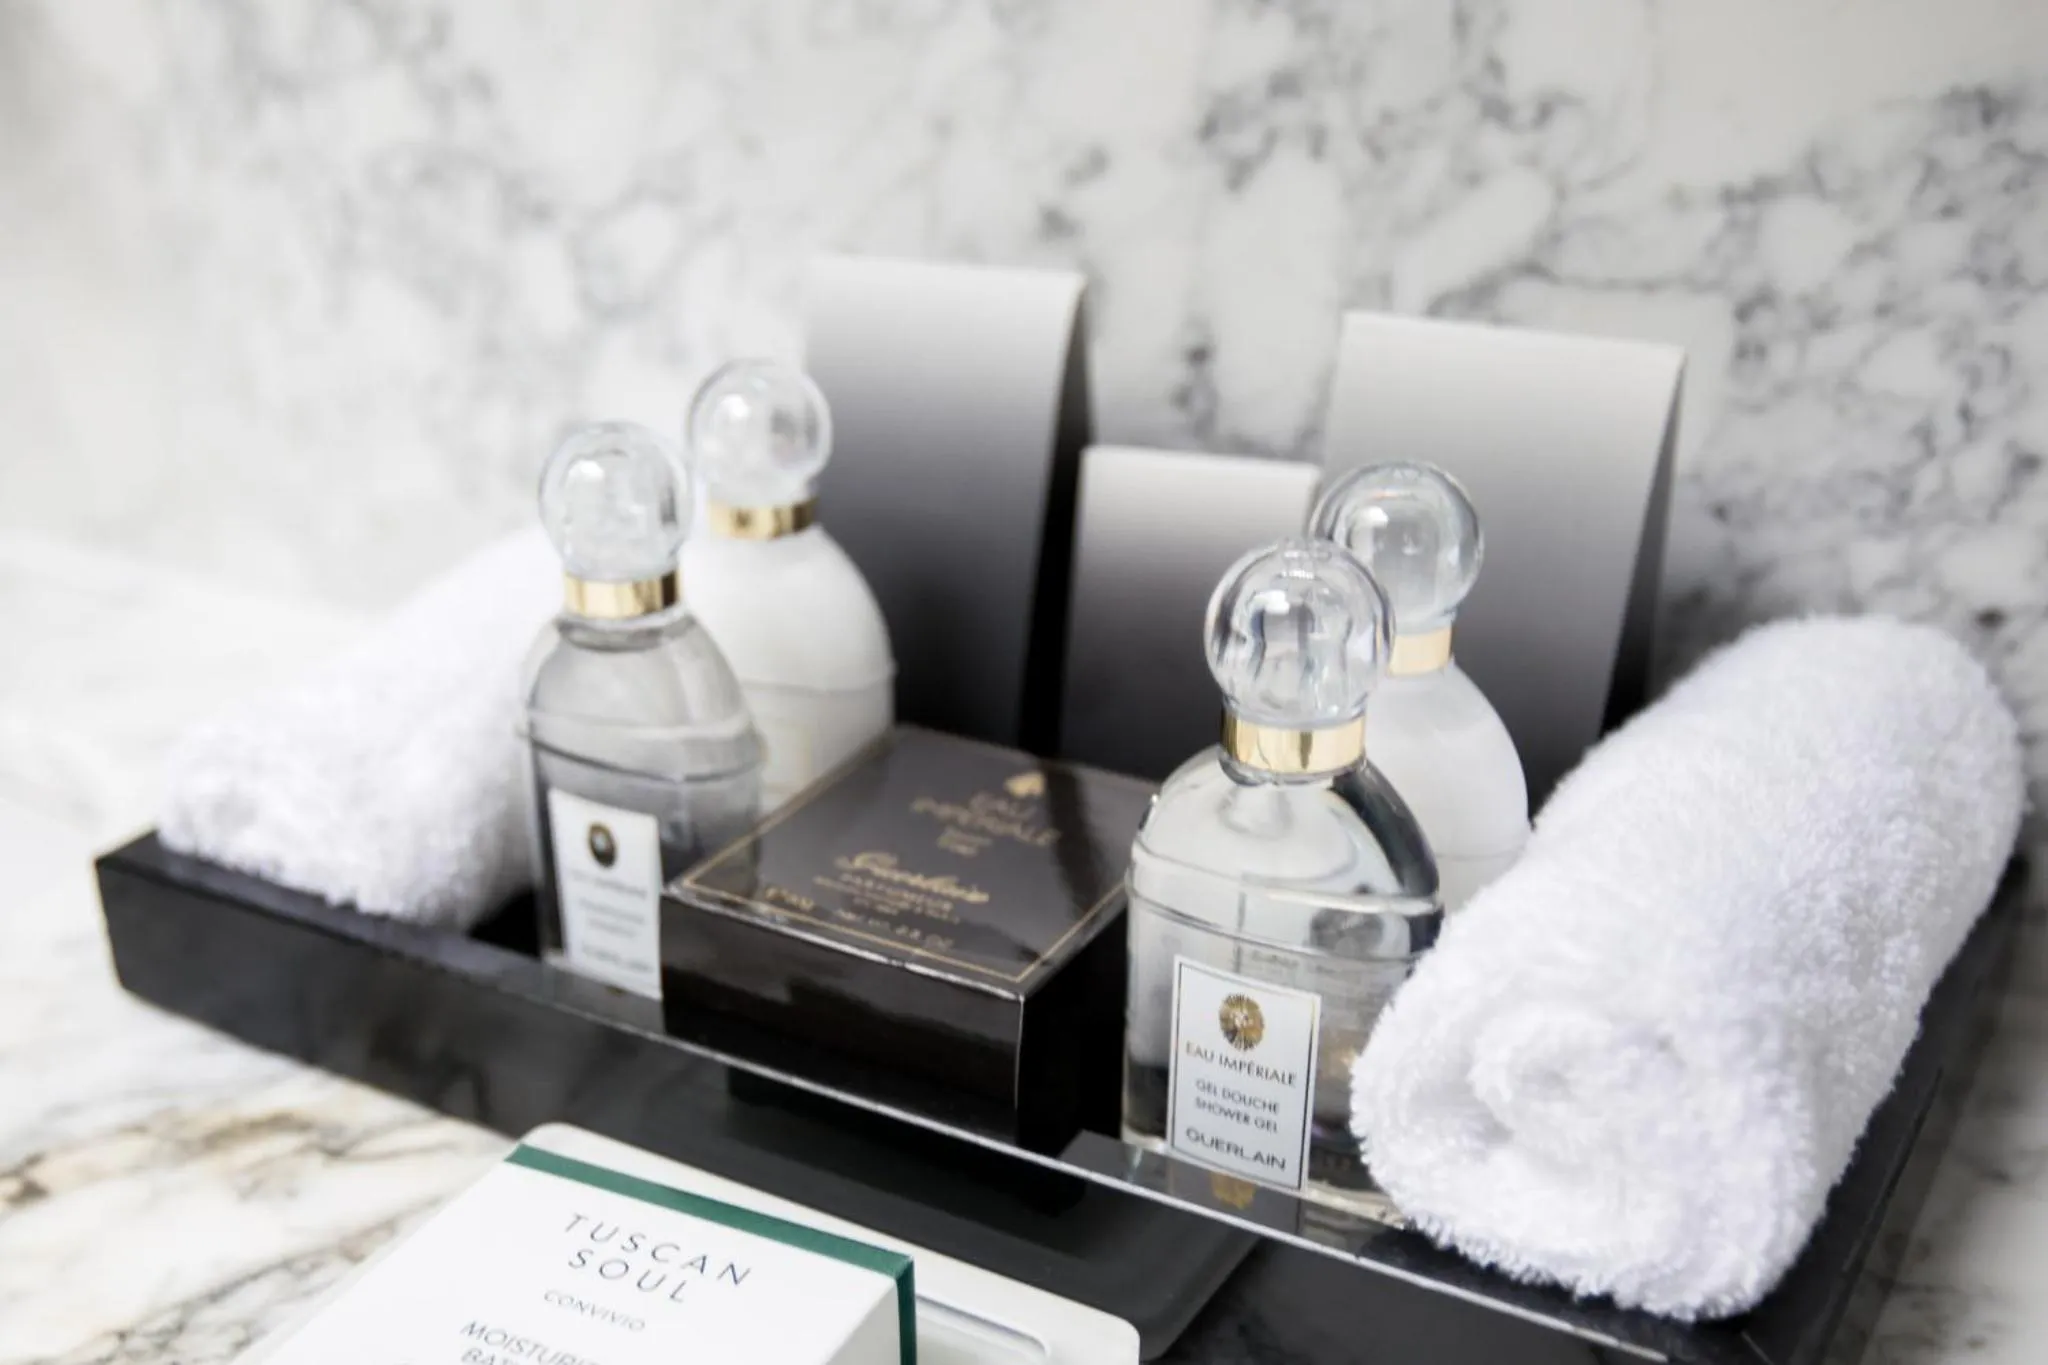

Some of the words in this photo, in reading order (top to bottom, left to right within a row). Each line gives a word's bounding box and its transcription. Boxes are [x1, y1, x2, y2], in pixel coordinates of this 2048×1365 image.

[1186, 1040, 1214, 1062] EAU
[1219, 1053, 1297, 1088] IMPÉRIALE
[1195, 1079, 1217, 1097] GEL
[1221, 1087, 1280, 1114] DOUCHE
[1195, 1096, 1250, 1125] SHOWER
[1253, 1116, 1278, 1134] GEL
[1186, 1126, 1286, 1171] GUERLAIN
[565, 1212, 752, 1286] TUSCAN
[568, 1248, 688, 1303] SOUL
[544, 1289, 645, 1332] CONVIVIO
